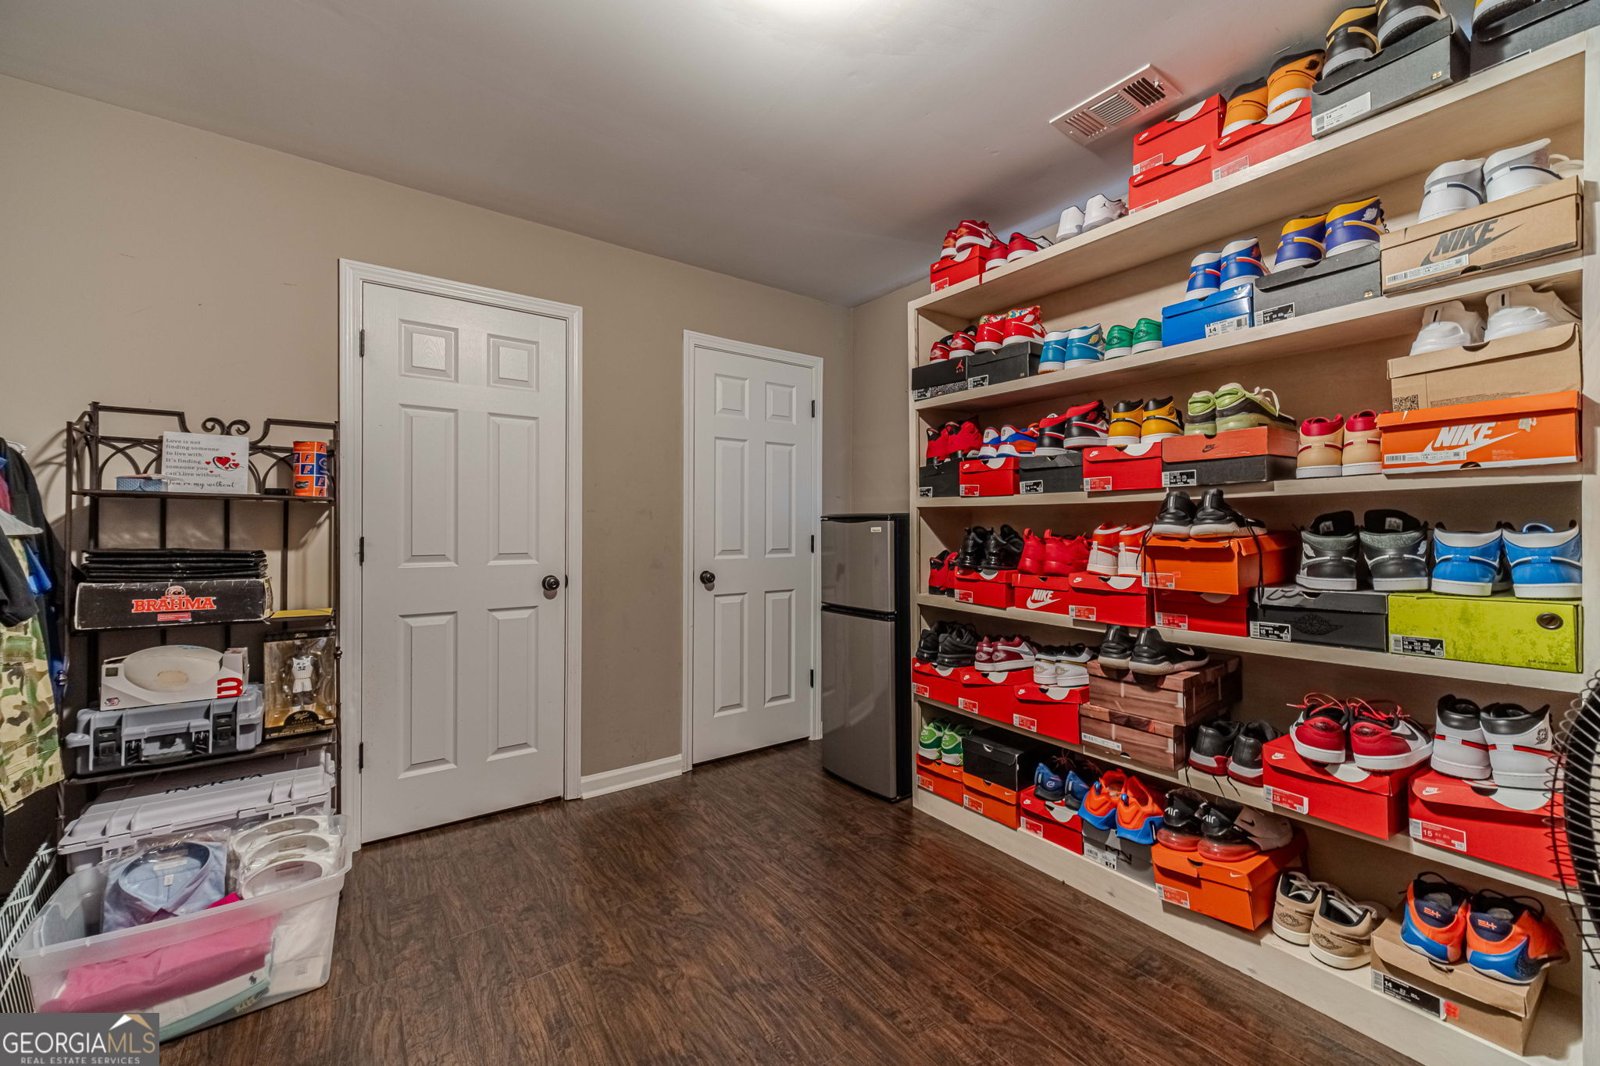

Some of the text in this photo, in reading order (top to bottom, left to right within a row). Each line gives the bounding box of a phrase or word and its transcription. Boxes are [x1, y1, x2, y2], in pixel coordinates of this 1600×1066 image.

[1433, 219, 1499, 257] NIKE
[1434, 422, 1497, 448] NIKE
[193, 481, 205, 489] my
[206, 480, 235, 488] without
[1031, 589, 1054, 602] NIKE
[131, 596, 217, 613] BRAHMA
[1423, 829, 1433, 837] 15
